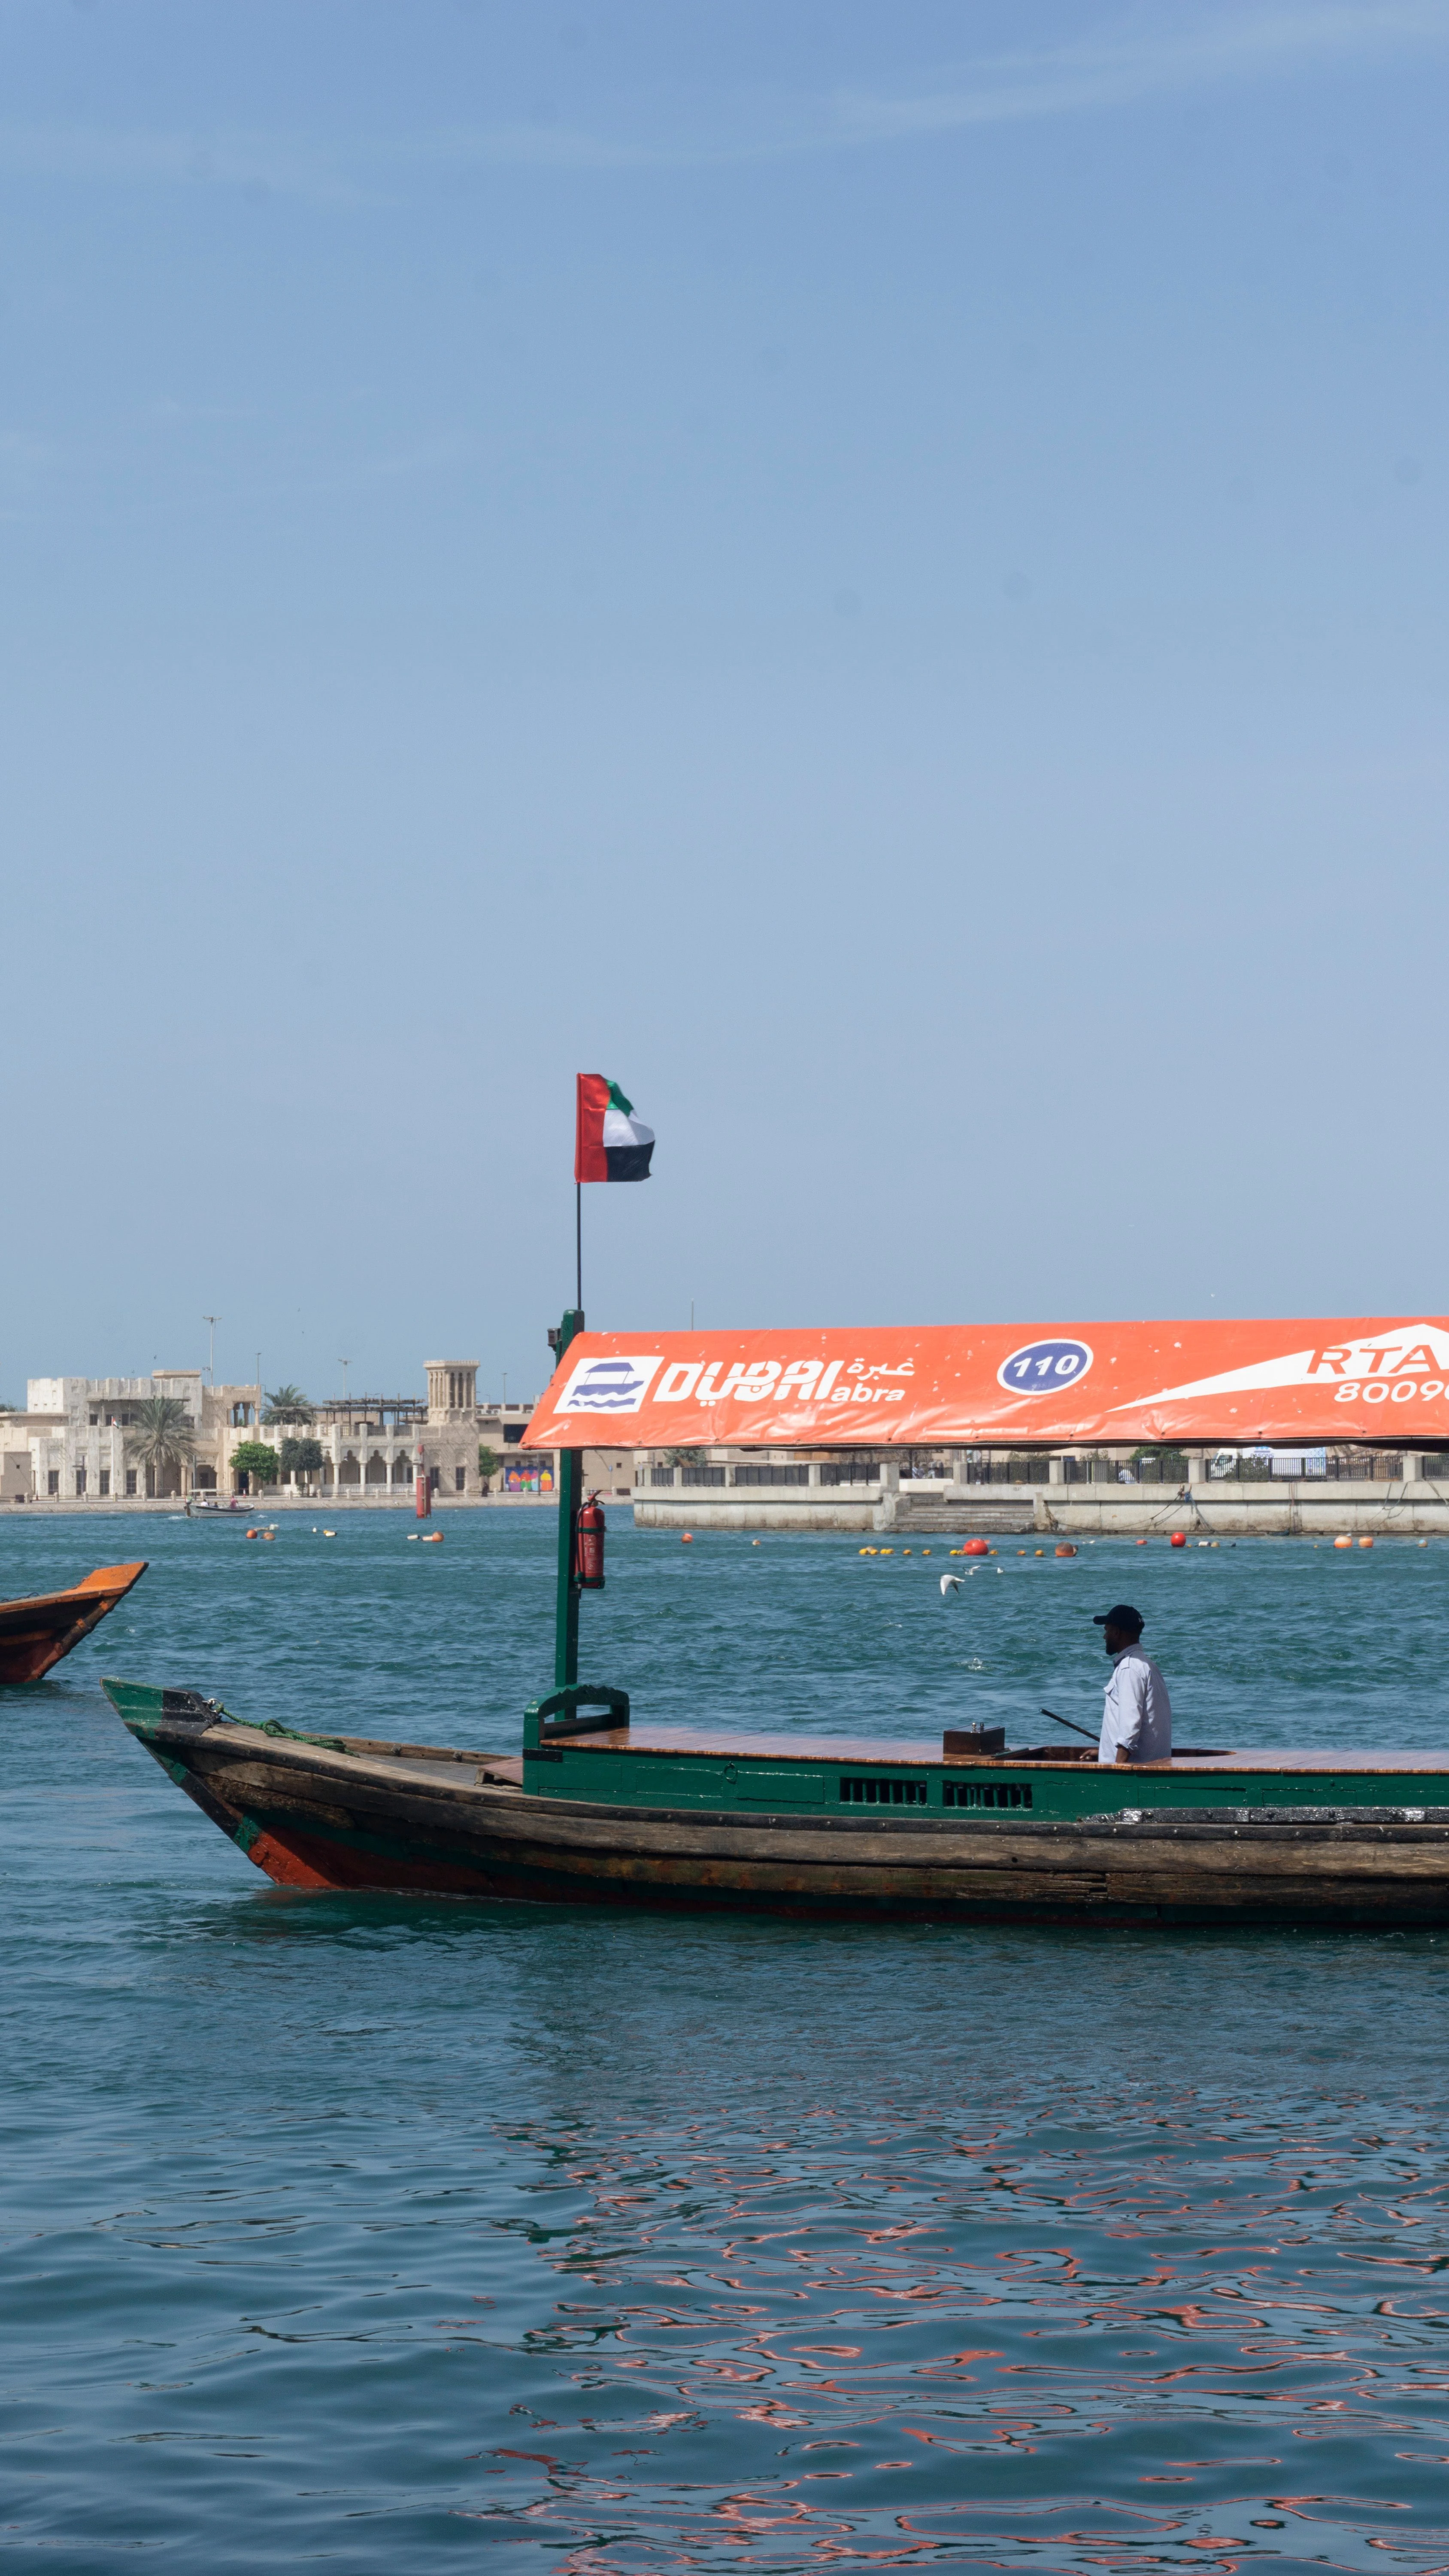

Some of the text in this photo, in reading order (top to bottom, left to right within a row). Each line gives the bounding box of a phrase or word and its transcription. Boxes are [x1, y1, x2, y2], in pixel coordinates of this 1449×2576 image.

[1013, 1355, 1079, 1377] 110
[1307, 1345, 1441, 1375] RTA
[652, 1361, 845, 1405] DUBAI
[831, 1383, 905, 1402] abra
[1334, 1380, 1449, 1403] 8009
